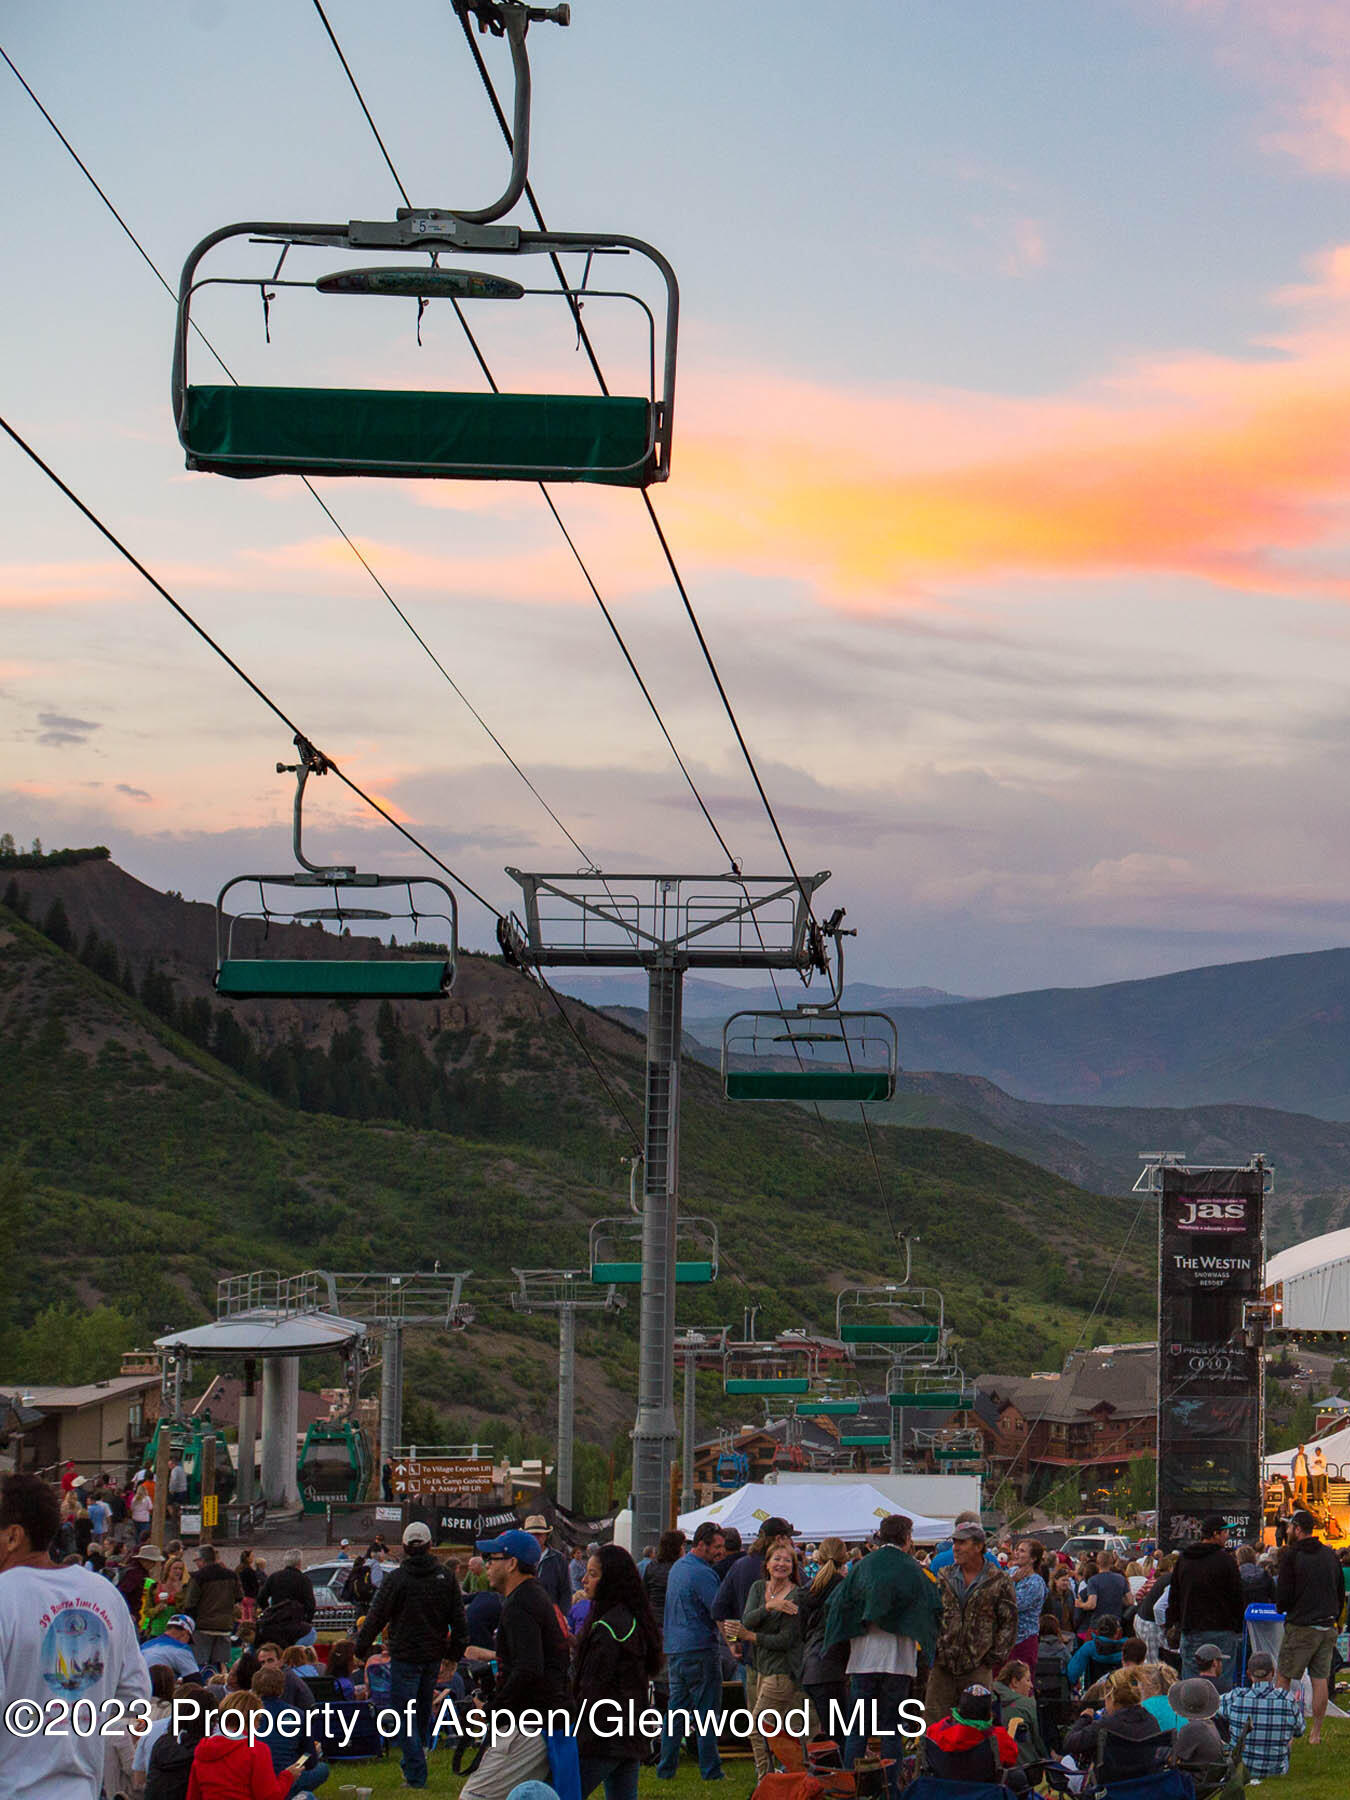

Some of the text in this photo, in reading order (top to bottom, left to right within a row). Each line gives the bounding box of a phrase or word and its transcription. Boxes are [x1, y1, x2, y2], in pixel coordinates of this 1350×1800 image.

[419, 220, 427, 233] 5
[1178, 1203, 1245, 1225] jas
[1173, 1255, 1251, 1270] THE WESTIN
[1194, 1271, 1231, 1279] SNOWMASS
[312, 1494, 348, 1502] SNOWMASS
[441, 1512, 516, 1530] ASPEN SNOWMASS
